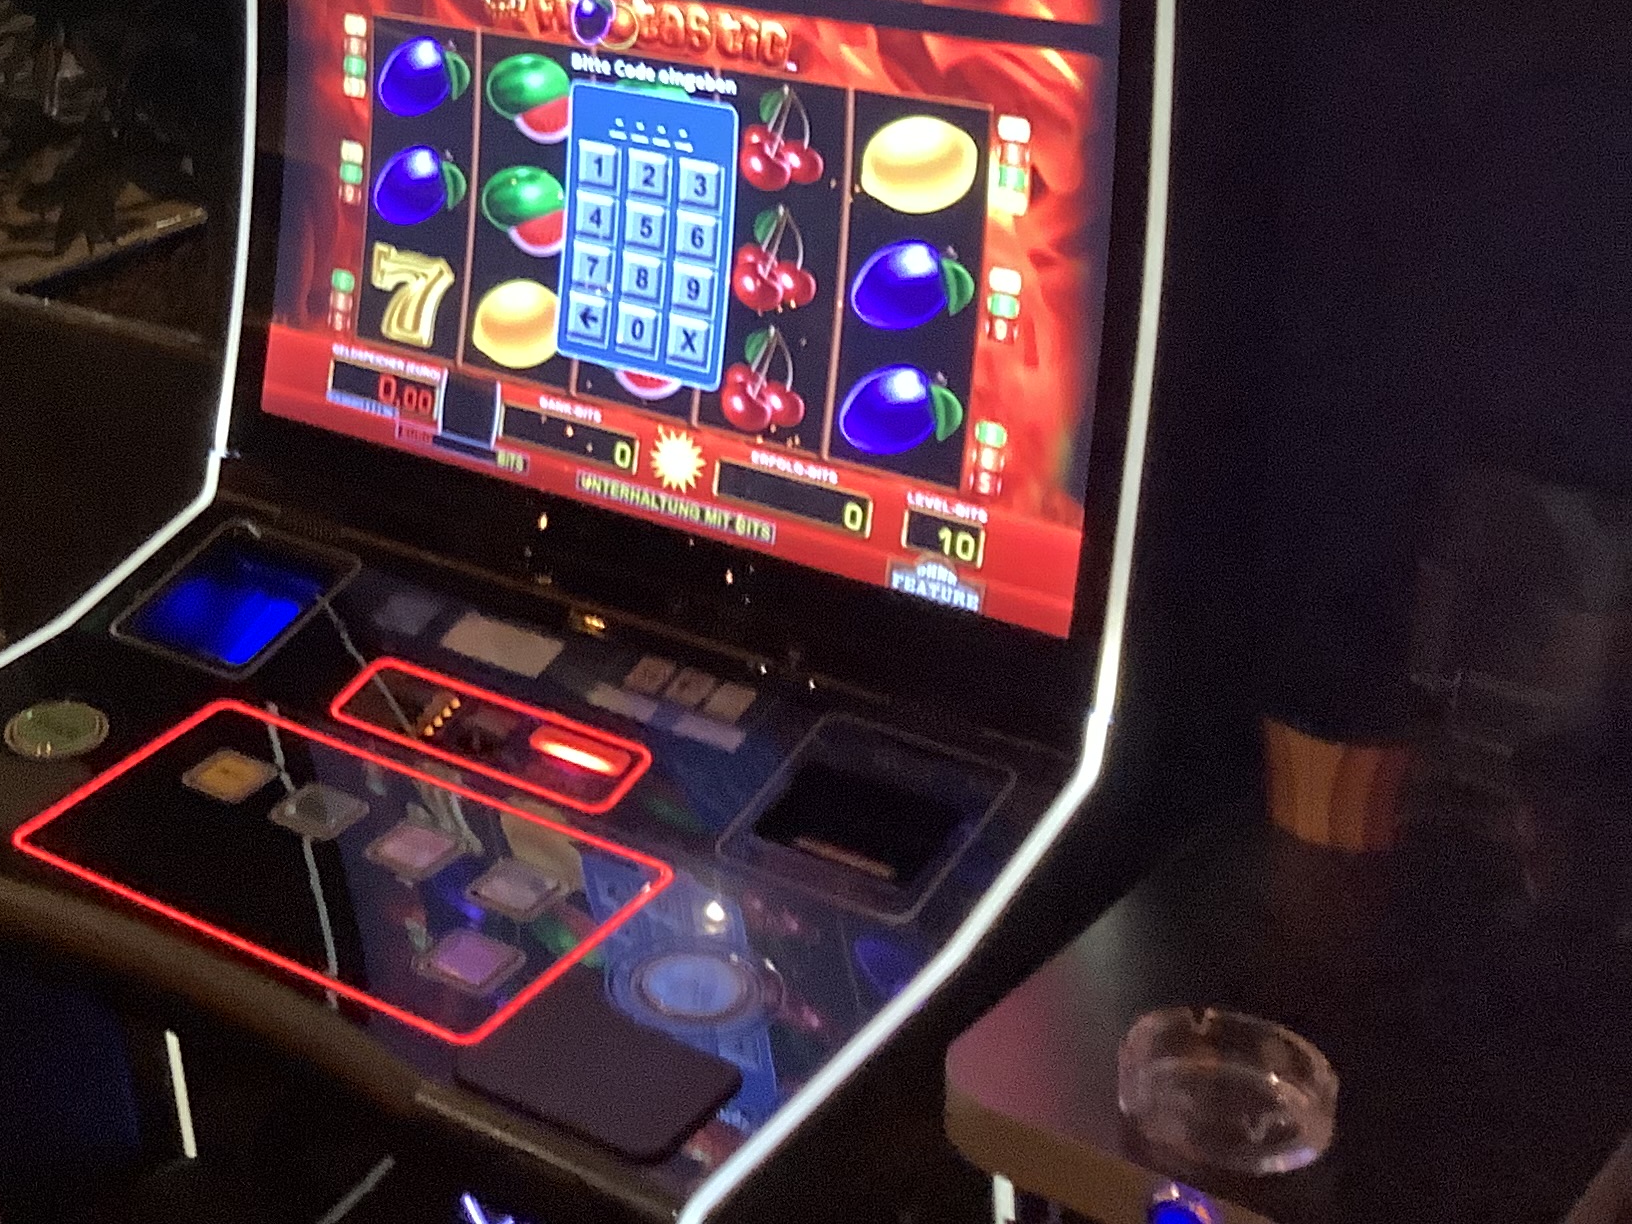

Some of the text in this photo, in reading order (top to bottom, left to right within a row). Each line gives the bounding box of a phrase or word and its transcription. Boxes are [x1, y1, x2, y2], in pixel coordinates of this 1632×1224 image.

[571, 52, 737, 96] Bitte Code eingeben
[592, 155, 707, 198] 1 2 3
[588, 207, 704, 250] 4 5 6
[586, 255, 701, 302] 7 8 9
[630, 317, 698, 354] 0 X
[613, 441, 632, 469] 0
[581, 475, 771, 542] UNTERHALTUNG MIT BITS
[843, 500, 863, 532] 0
[906, 491, 988, 524] LEVEL-BITS
[937, 526, 975, 561] 10
[892, 569, 979, 613] FEATURE
